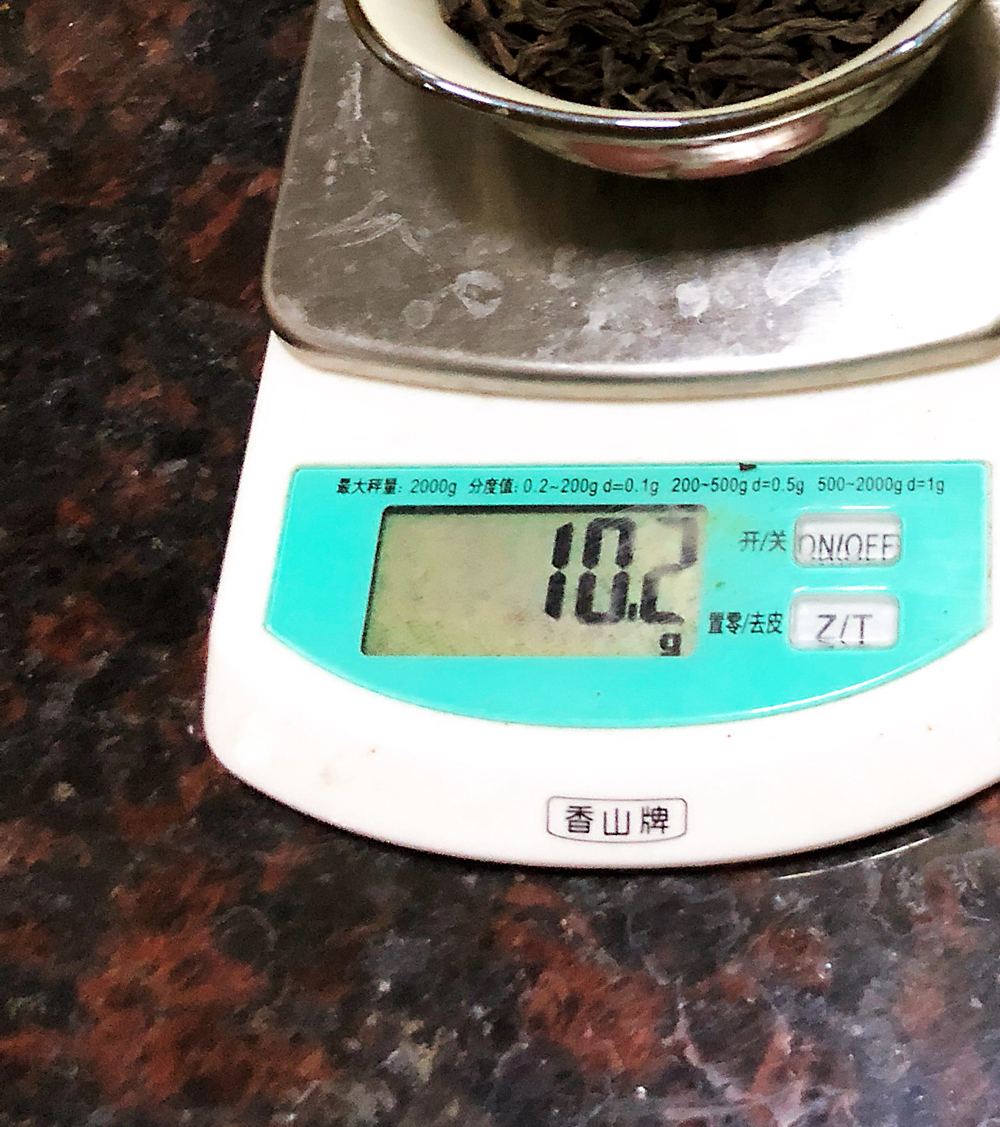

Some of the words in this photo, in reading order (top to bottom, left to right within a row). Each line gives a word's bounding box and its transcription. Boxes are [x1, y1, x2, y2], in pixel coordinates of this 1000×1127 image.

[410, 478, 457, 497] 2000g
[906, 477, 945, 495] d=1g
[738, 529, 788, 553] 开/关
[798, 533, 902, 562] ON/OFF
[544, 516, 699, 625] 10.2
[707, 611, 784, 636] 置零/去皮
[816, 613, 874, 647] Z/T
[658, 632, 682, 657] g
[565, 805, 670, 836] 香山牌
